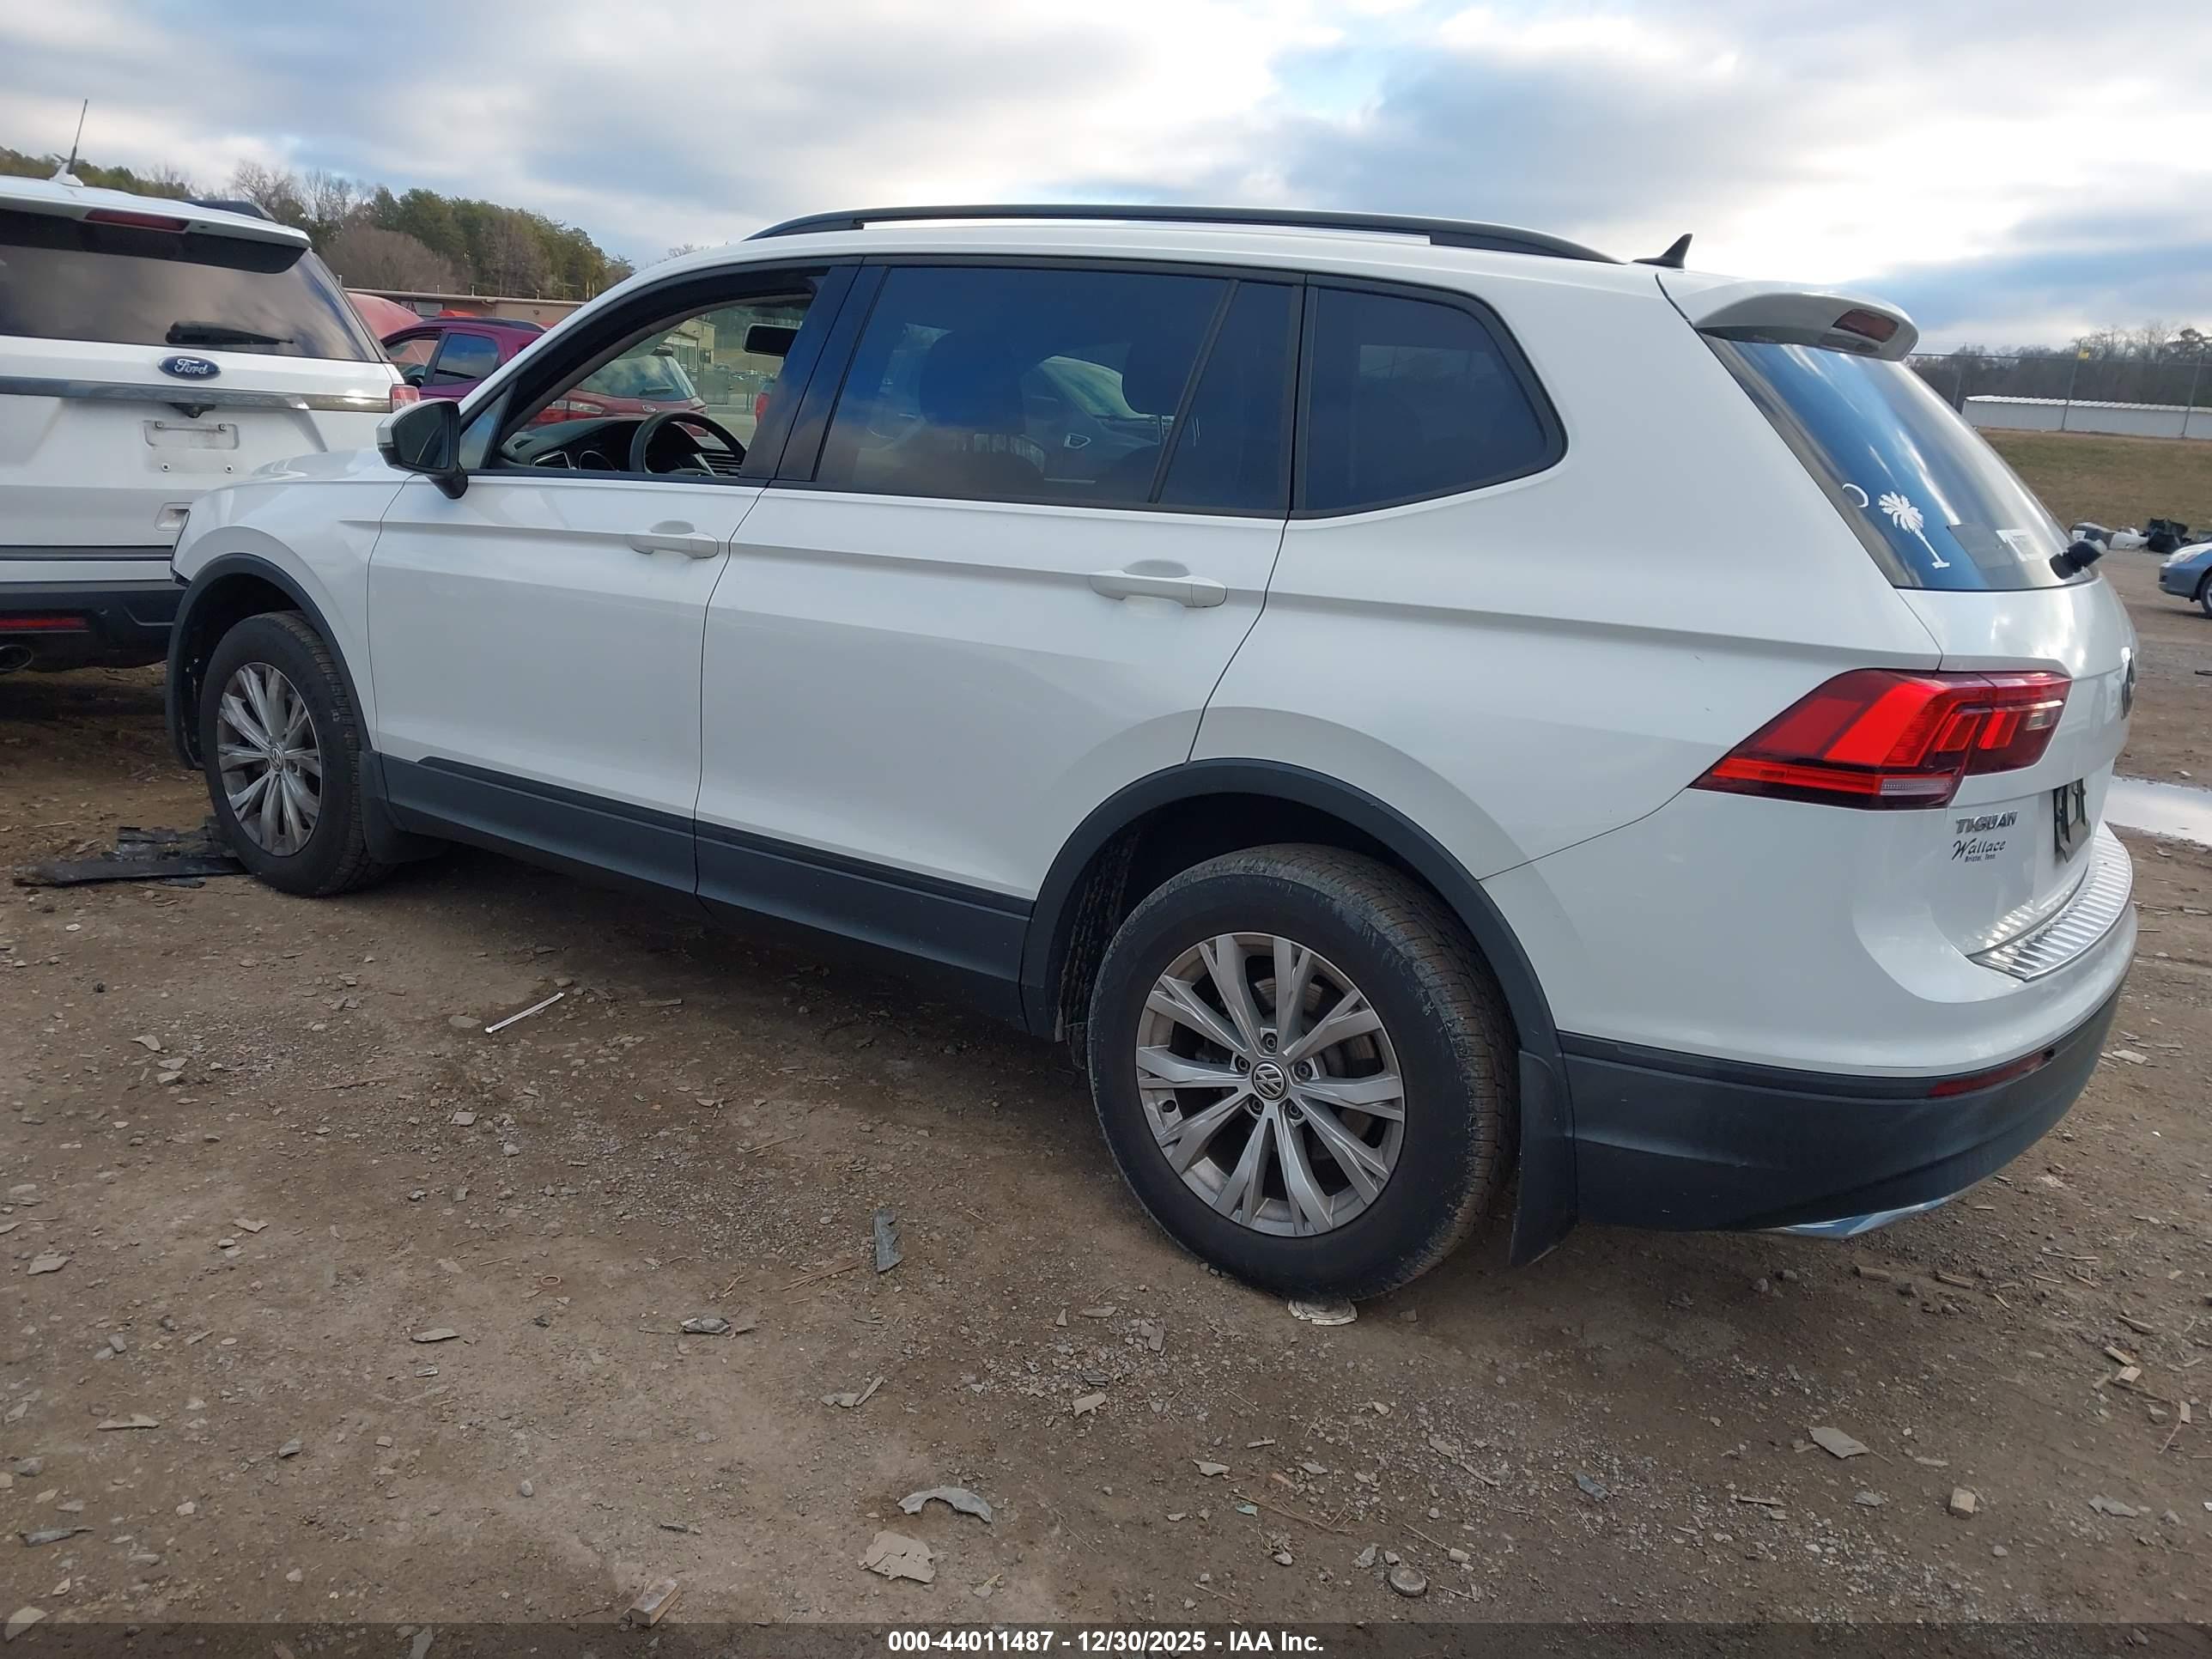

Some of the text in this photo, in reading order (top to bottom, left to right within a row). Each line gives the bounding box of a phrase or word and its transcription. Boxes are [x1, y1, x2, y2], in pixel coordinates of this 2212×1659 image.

[174, 358, 208, 374] Ford
[1956, 811, 2018, 834] TIGUAN
[1952, 838, 2006, 860] Wallace
